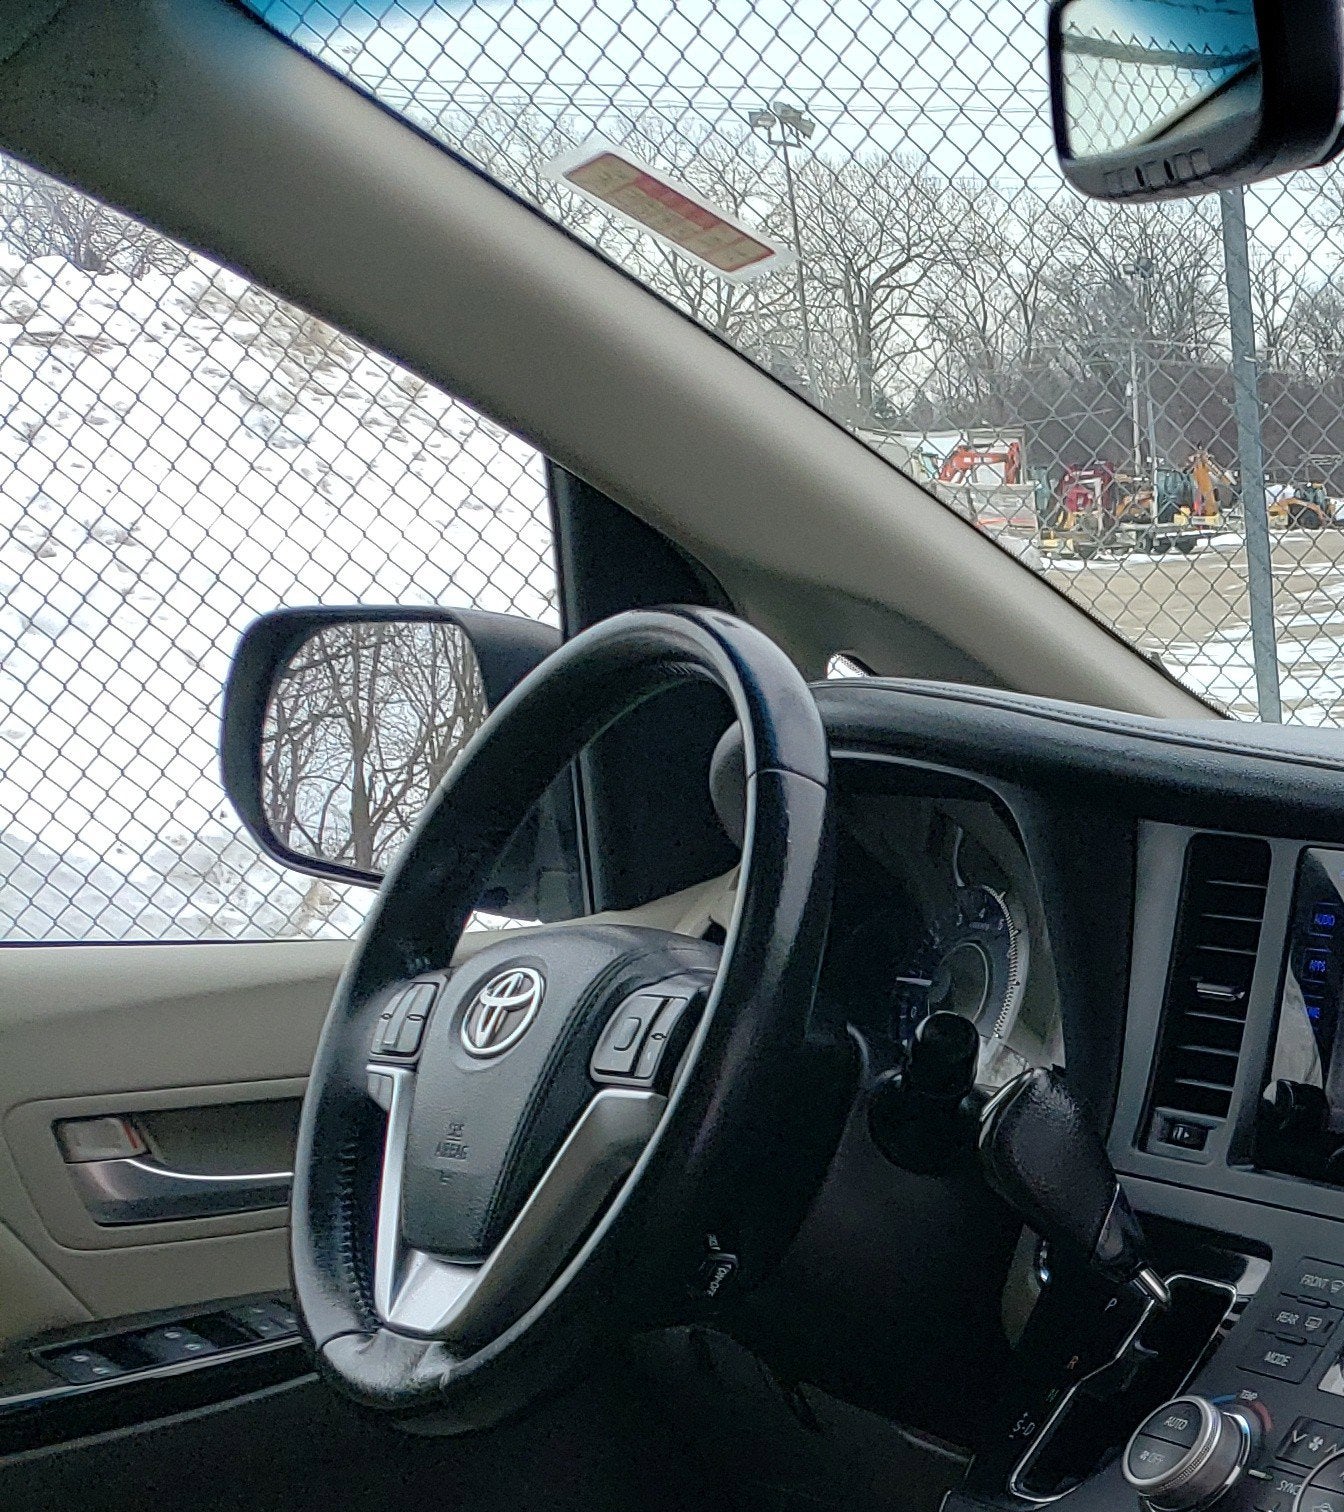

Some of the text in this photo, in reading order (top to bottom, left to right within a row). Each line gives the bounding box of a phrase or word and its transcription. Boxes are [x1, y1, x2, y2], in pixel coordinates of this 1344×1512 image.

[1301, 1273, 1329, 1290] FRONT
[1105, 1298, 1117, 1311] P
[1275, 1310, 1299, 1326] REAR
[1264, 1351, 1290, 1367] MODE
[1163, 1415, 1188, 1431] AUTO
